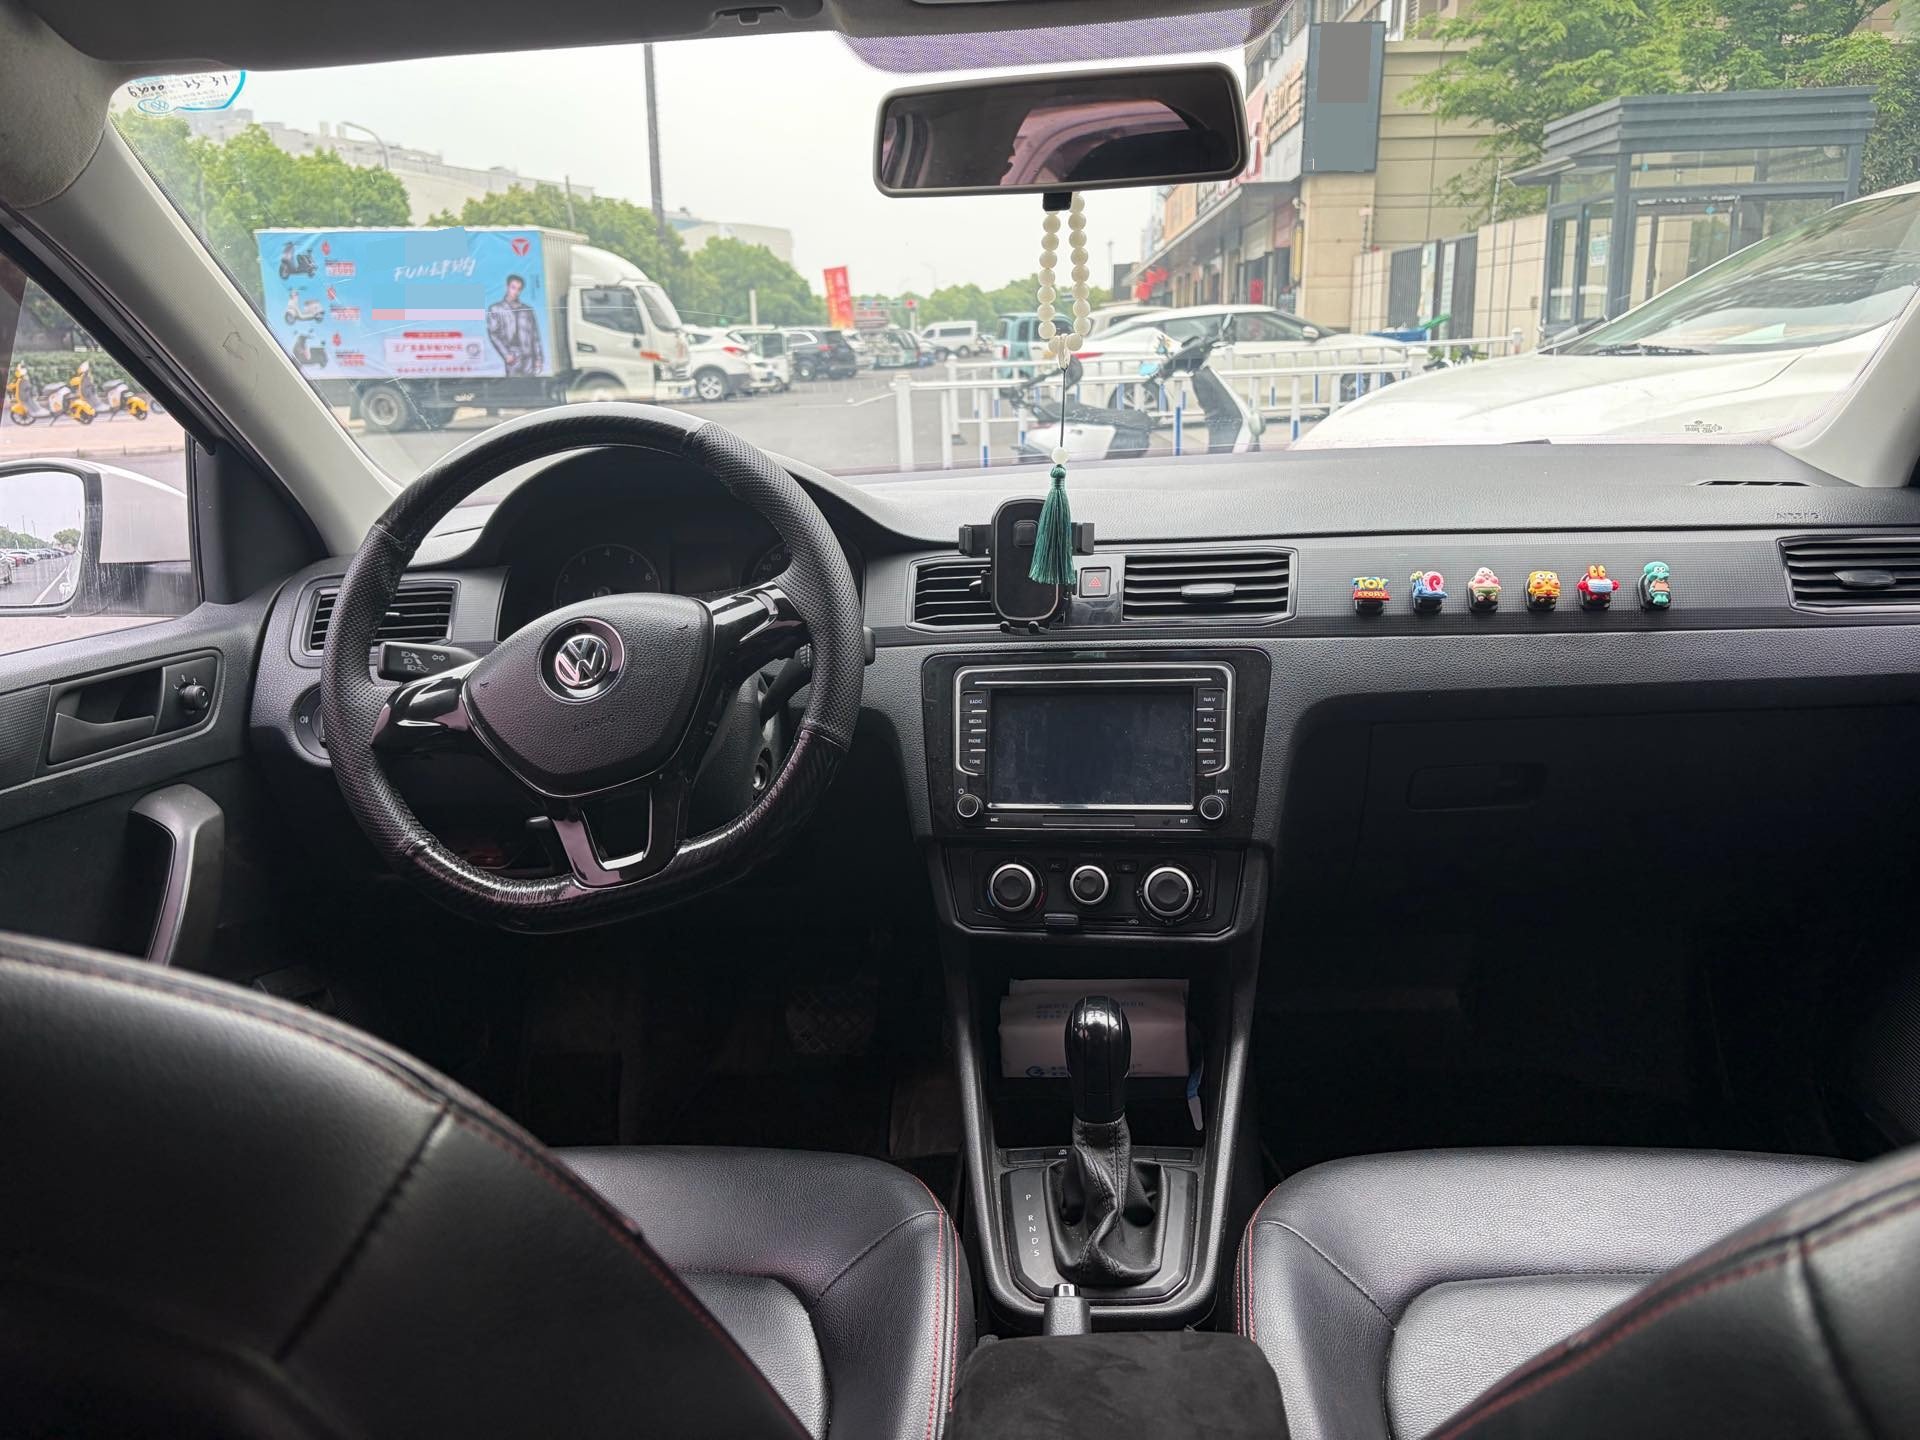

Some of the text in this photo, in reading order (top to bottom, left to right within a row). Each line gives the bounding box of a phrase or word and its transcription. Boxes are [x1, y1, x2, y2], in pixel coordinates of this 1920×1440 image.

[1352, 576, 1390, 590] TOY
[1025, 1193, 1032, 1201] P
[1031, 1237, 1039, 1245] D
[1033, 1249, 1040, 1257] S
